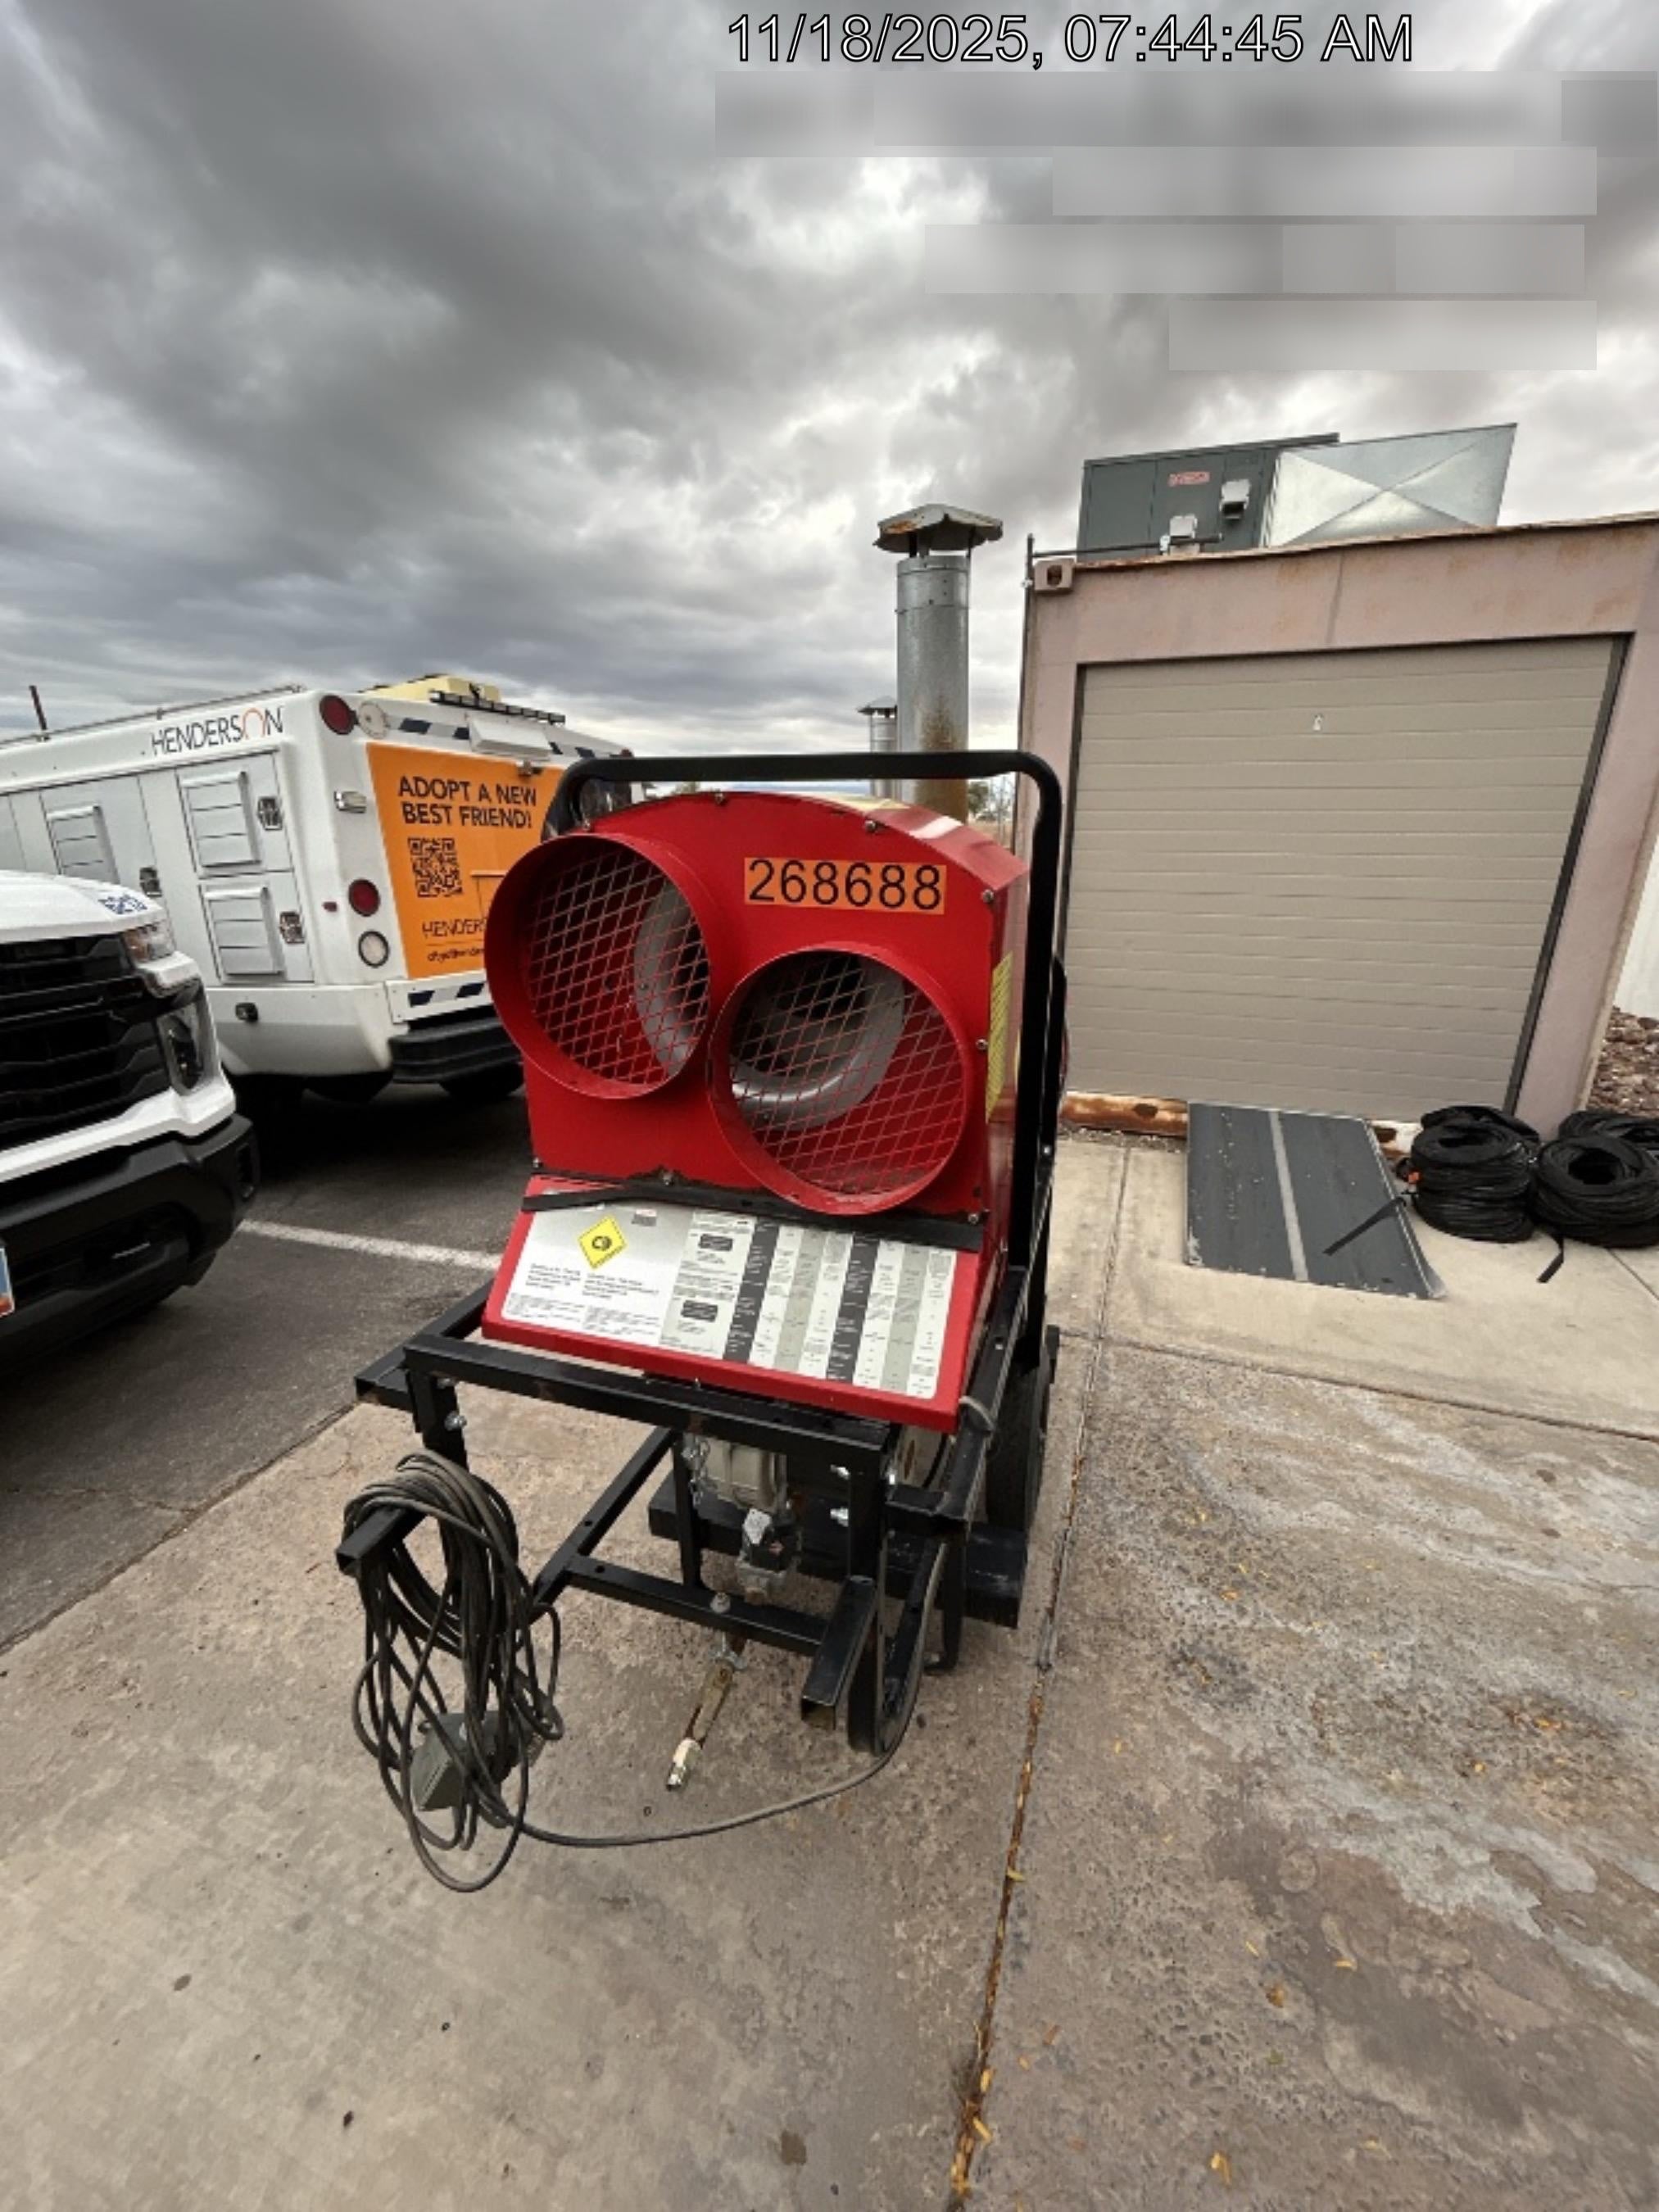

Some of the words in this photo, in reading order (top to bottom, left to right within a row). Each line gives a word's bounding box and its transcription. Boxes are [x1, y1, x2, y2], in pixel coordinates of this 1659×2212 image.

[152, 708, 283, 756] HENDERSON
[398, 776, 470, 801] ADOPT
[478, 784, 492, 803] A
[496, 784, 537, 805] NEW
[402, 801, 452, 824] BEST
[459, 805, 532, 828] FRIEND!
[749, 859, 941, 909] 268688
